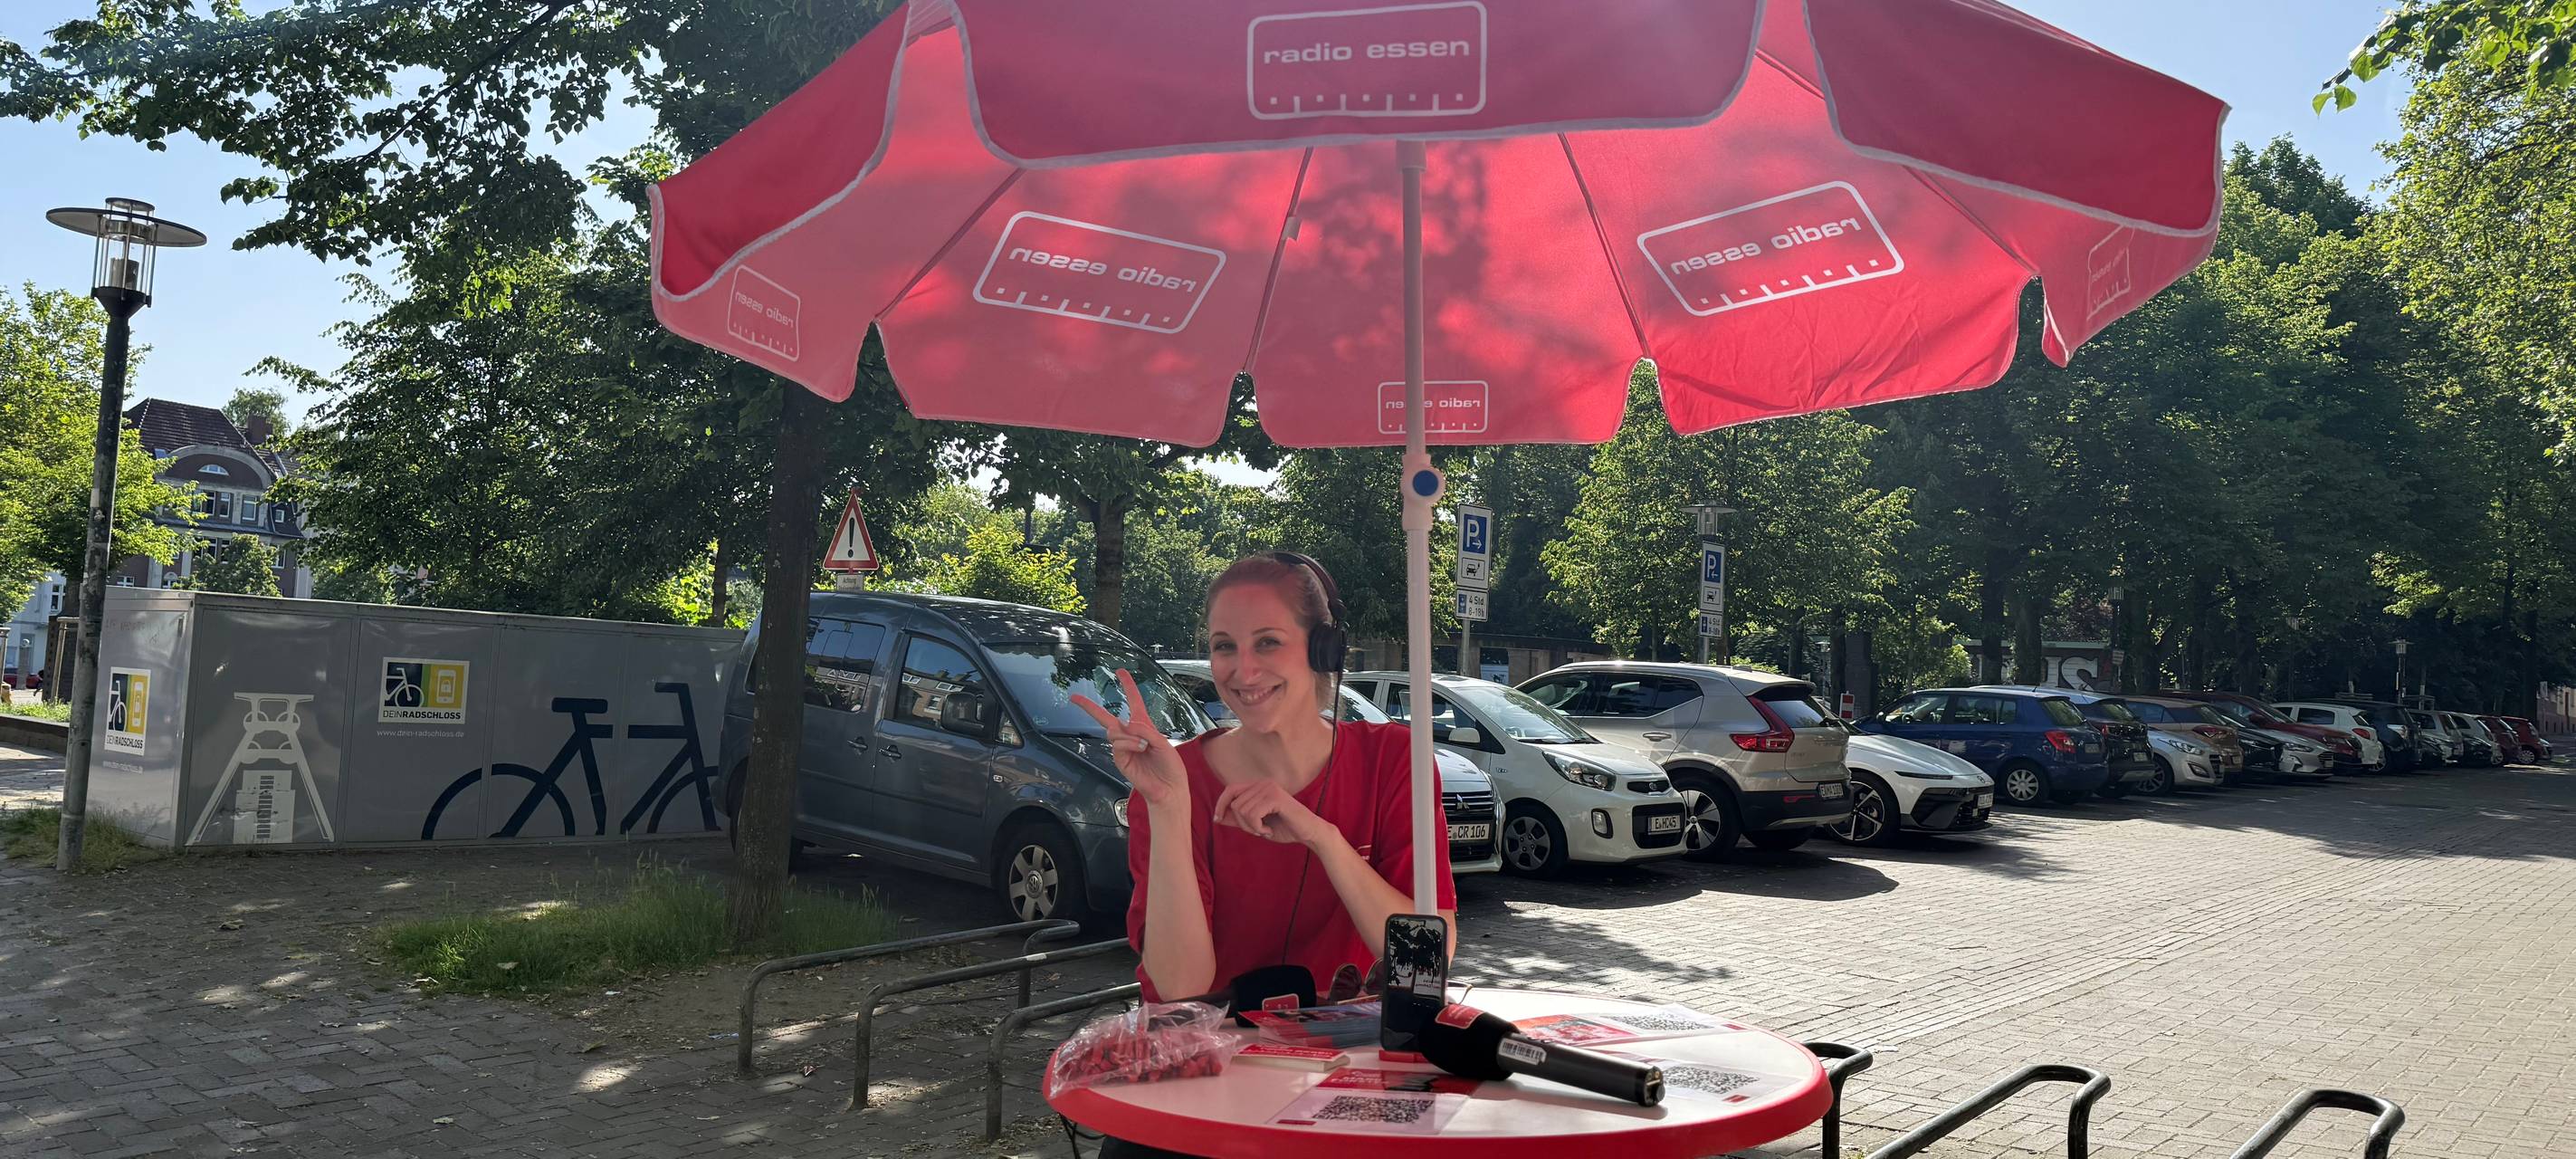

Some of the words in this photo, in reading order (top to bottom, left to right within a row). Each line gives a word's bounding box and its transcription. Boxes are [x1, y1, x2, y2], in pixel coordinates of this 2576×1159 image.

[1264, 43, 1352, 64] radio
[1367, 41, 1470, 59] essen
[1466, 519, 1480, 548] P
[1707, 553, 1716, 578] P
[383, 710, 461, 719] DEINRADSCHLOSS
[1458, 826, 1469, 838] CR
[1470, 825, 1485, 838] 106
